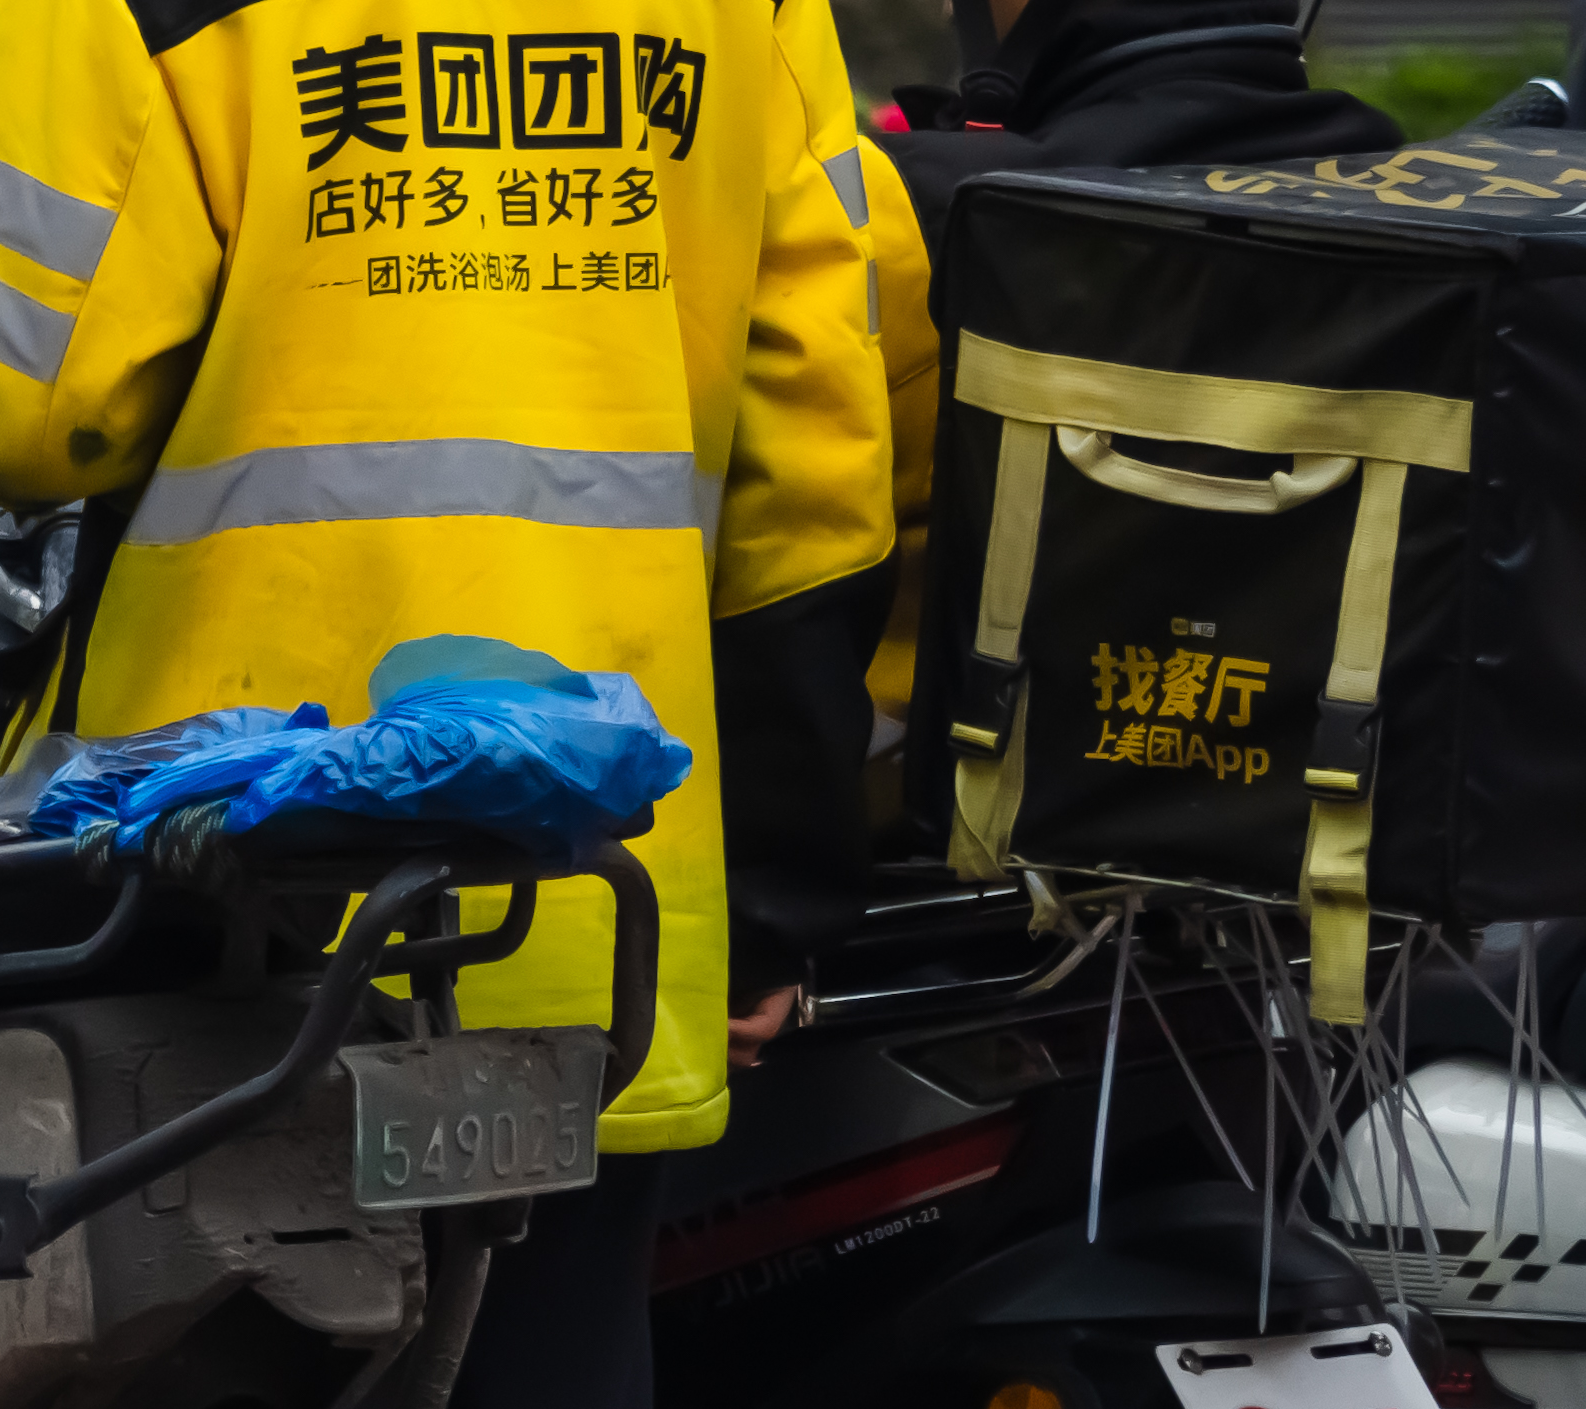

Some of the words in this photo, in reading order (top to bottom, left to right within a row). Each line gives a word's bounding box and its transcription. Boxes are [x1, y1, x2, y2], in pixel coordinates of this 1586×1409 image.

[291, 31, 706, 172] 美团团购
[1091, 643, 1271, 728] 找餐厅
[1084, 719, 1271, 785] 上美团App
